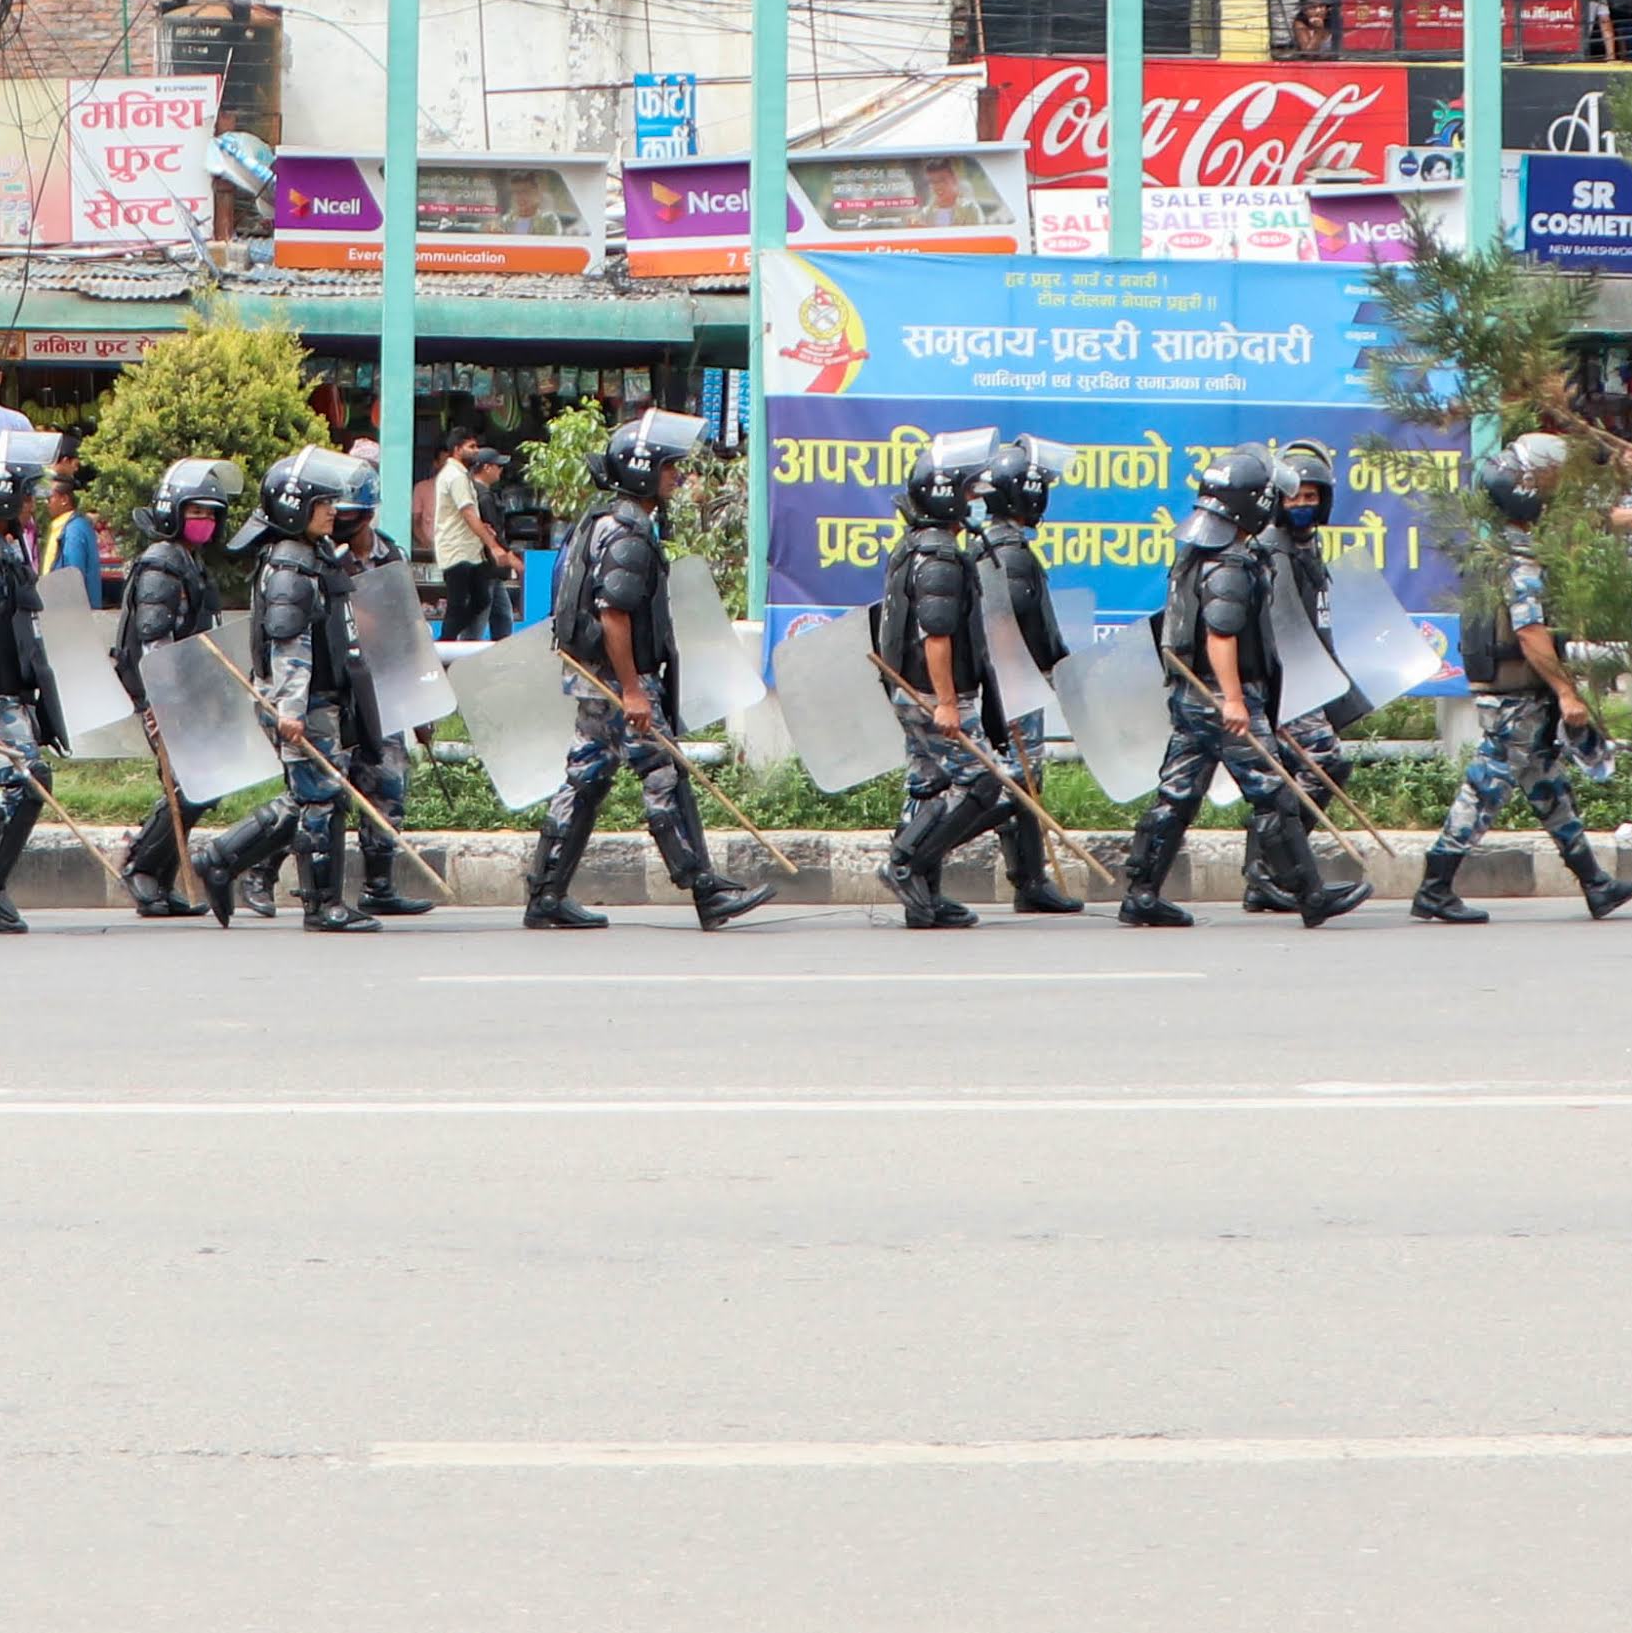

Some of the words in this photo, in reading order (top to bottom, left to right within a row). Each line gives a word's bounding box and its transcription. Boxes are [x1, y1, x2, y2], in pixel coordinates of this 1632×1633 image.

[80, 90, 207, 130] मनिश
[104, 144, 184, 183] फ्रुट
[313, 196, 361, 215] Ncell
[687, 189, 749, 214] Ncel
[1151, 192, 1213, 209] SALE
[1571, 180, 1616, 210] SR
[1249, 210, 1311, 229] SAL
[415, 251, 506, 264] ommunication
[1549, 245, 1571, 256] NEW
[32, 335, 88, 355] मनिश
[94, 336, 129, 357] फ्रुट
[1151, 321, 1314, 365] साझेदारी
